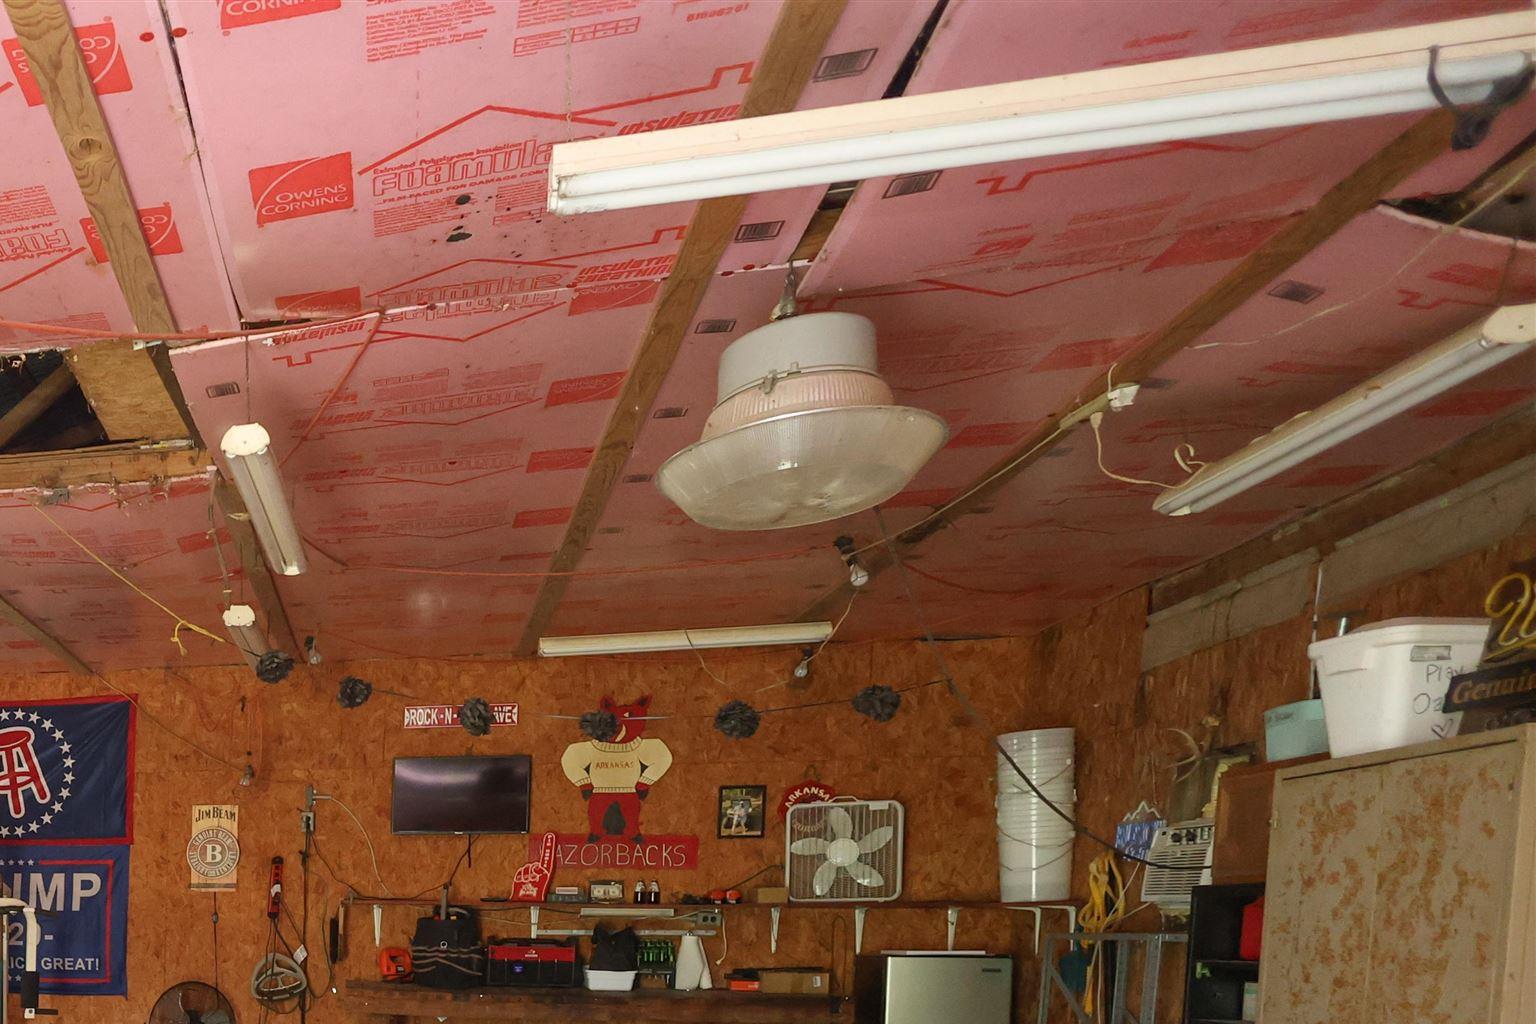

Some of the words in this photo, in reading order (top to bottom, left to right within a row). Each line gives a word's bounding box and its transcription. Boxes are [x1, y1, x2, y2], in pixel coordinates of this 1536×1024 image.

[373, 139, 553, 197] FOAMULA
[276, 183, 346, 203] OWENS
[261, 194, 348, 215] CORNING
[595, 761, 634, 770] ARKANSAS
[785, 786, 832, 808] ARKANSA
[196, 809, 211, 822] JIM
[212, 806, 236, 822] BEAM
[204, 843, 222, 863] B
[553, 844, 686, 867] AZORBACKS
[41, 957, 100, 971] GREAT!
